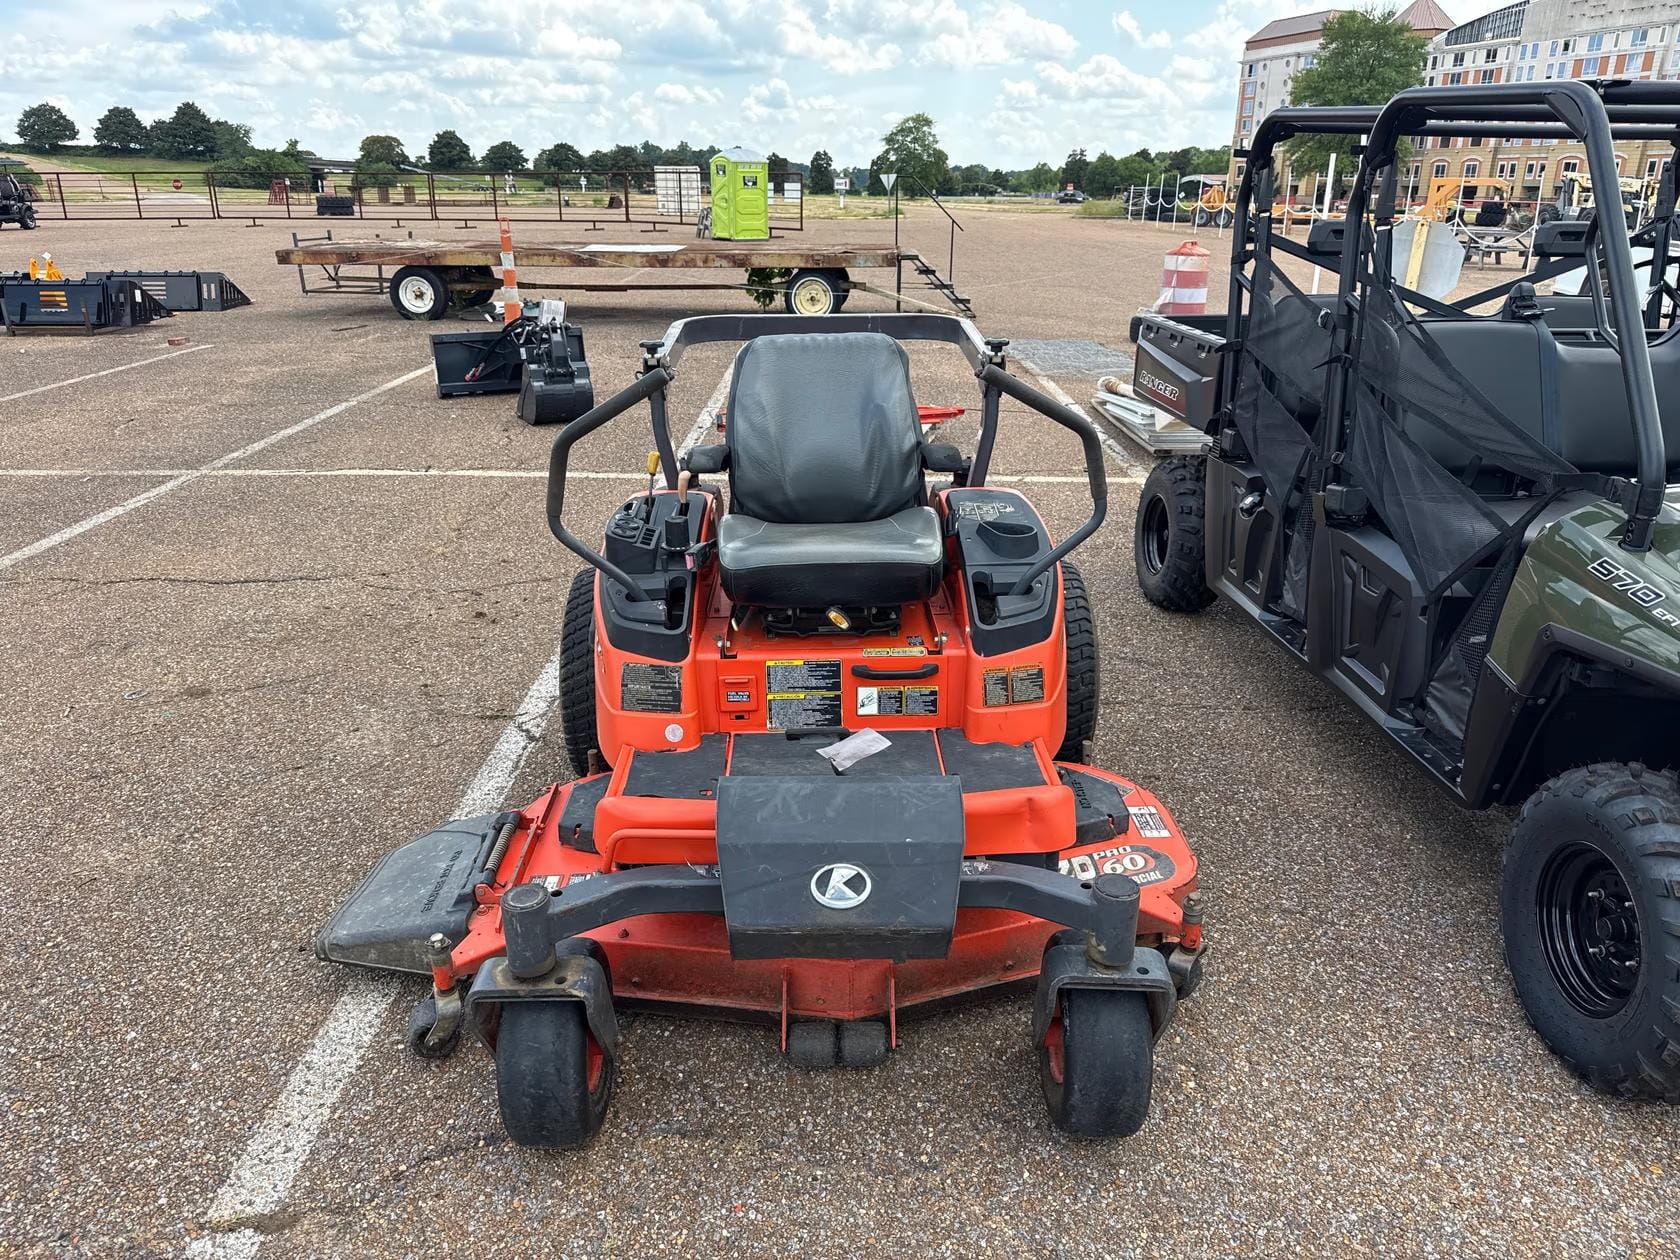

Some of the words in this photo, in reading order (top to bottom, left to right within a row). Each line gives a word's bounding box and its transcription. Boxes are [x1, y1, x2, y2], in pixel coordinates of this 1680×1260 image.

[1140, 370, 1179, 401] RANGER
[1587, 557, 1666, 607] 570
[1092, 845, 1132, 860] PRO
[1102, 854, 1146, 875] 60
[1128, 870, 1164, 884] RCIAL
